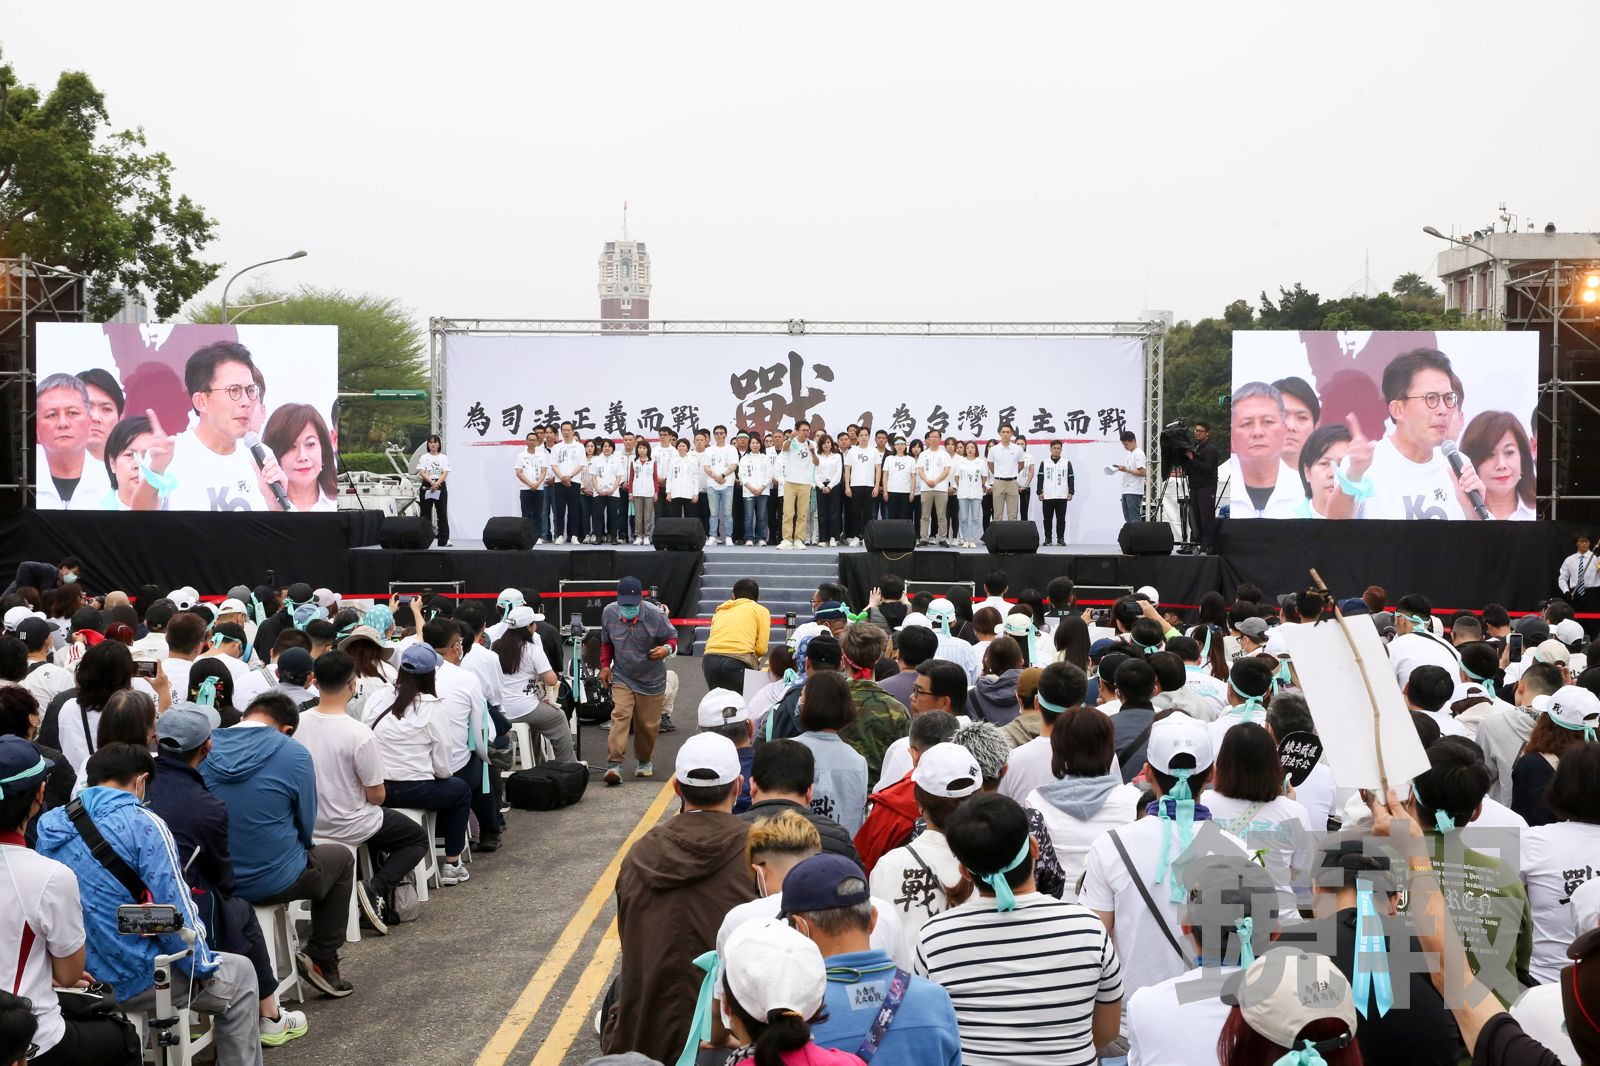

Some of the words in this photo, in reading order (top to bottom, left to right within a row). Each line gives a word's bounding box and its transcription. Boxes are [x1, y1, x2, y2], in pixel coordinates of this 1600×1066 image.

[463, 400, 701, 438] 為司法正義而戰
[887, 402, 1128, 439] 為台灣民主而戰
[1280, 754, 1311, 770] 司法不公
[893, 866, 940, 918] 戰
